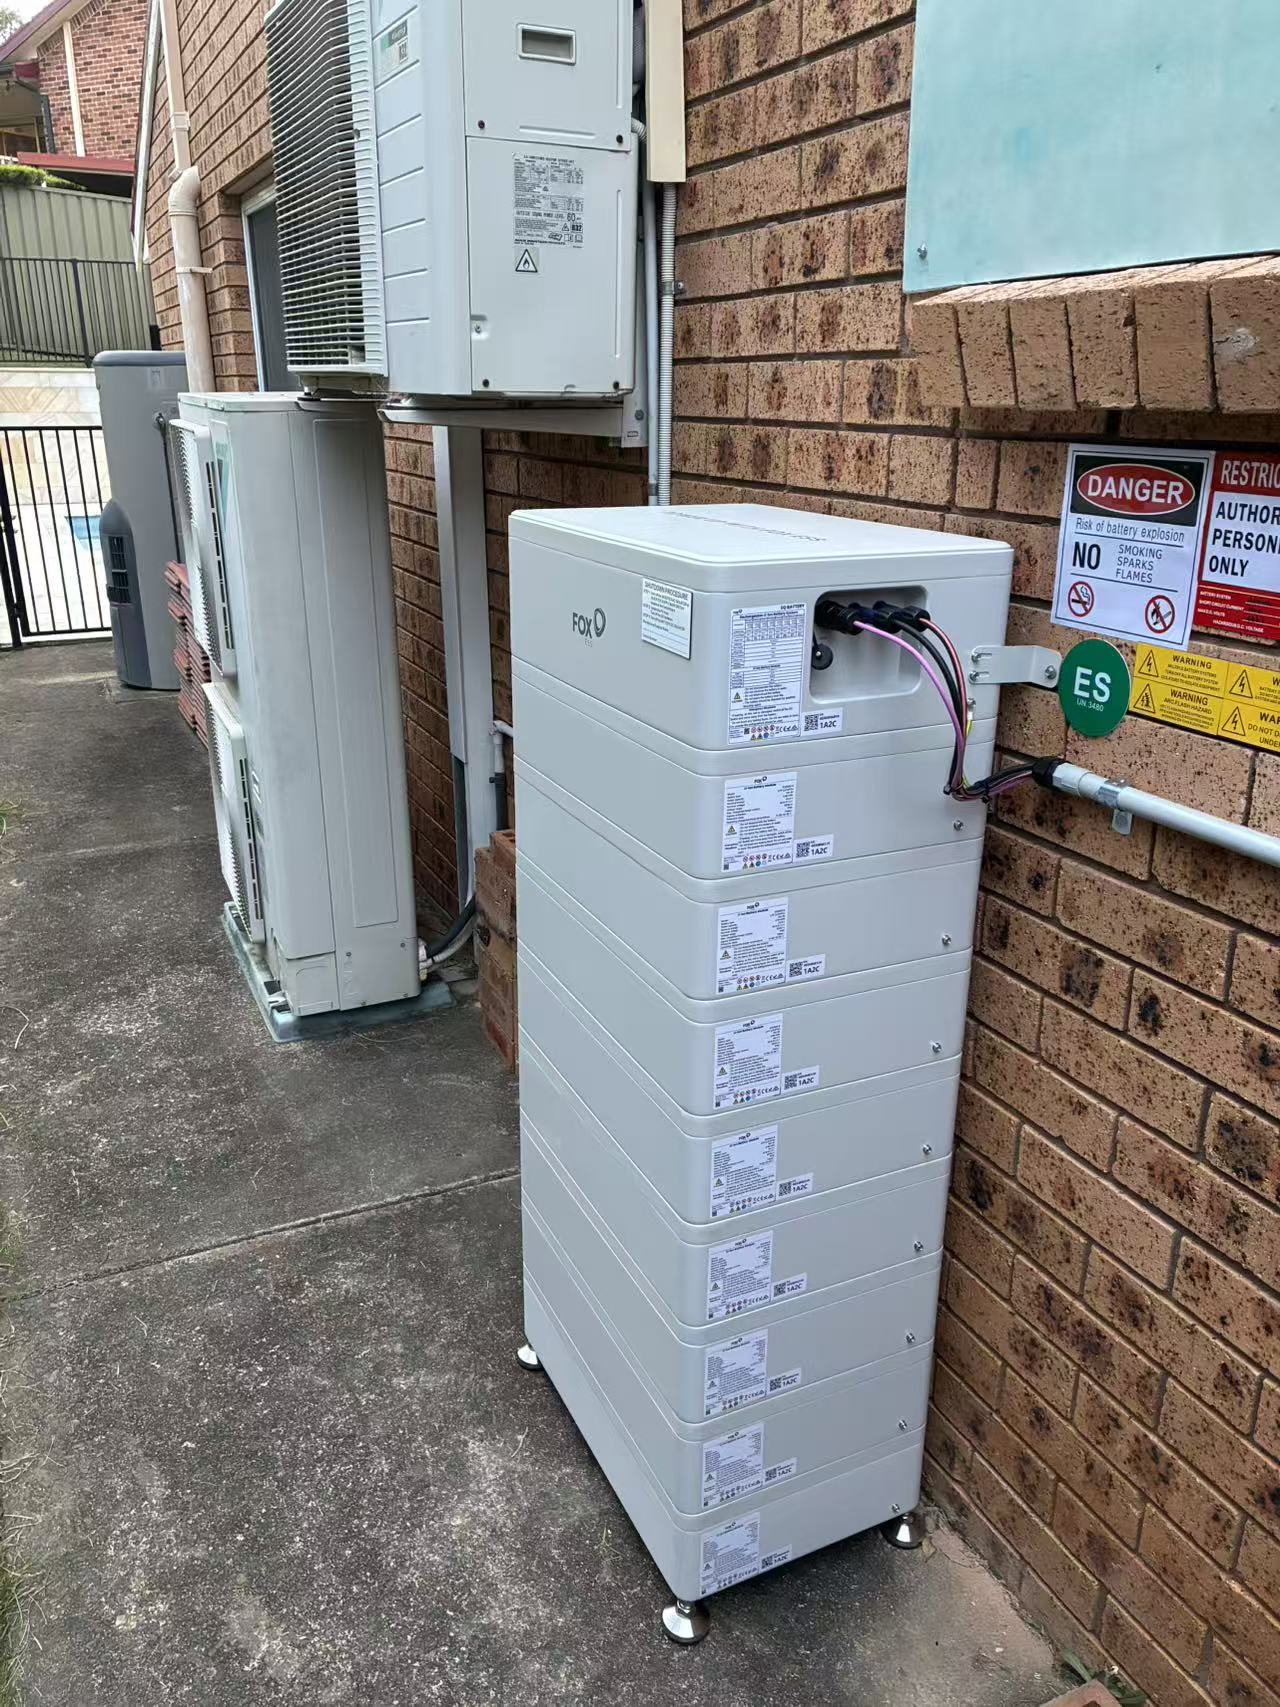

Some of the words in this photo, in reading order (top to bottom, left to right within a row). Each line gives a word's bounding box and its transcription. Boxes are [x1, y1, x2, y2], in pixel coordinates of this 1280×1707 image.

[1088, 475, 1184, 504] DANGER
[1216, 502, 1280, 525] AUTHOR
[1076, 518, 1092, 530] Risk
[1096, 520, 1105, 532] of
[1107, 522, 1137, 539] battery
[1141, 527, 1184, 542] explosion
[1212, 528, 1280, 554] PERSON
[1072, 542, 1100, 570] NO
[1118, 544, 1163, 559] SMOKING
[1117, 556, 1154, 571] SPARKS
[1209, 555, 1248, 577] ONLY
[1116, 568, 1152, 583] FLAMES
[645, 581, 664, 593] SHUTDOWN
[665, 587, 688, 600] PROCEDURE
[572, 612, 592, 638] FOX
[1172, 655, 1211, 669] WARNING
[1074, 666, 1111, 702] ES
[1171, 689, 1208, 705] WARNING
[1191, 704, 1212, 714] HAZARD
[1259, 727, 1273, 735] NOT
[1259, 737, 1280, 748] UNDE
[811, 847, 828, 855] 1A2C
[804, 966, 820, 974] 1A2C
[799, 1077, 814, 1086] 1A2C
[787, 1284, 802, 1292] 1A2C
[783, 1378, 797, 1386] 1A2C
